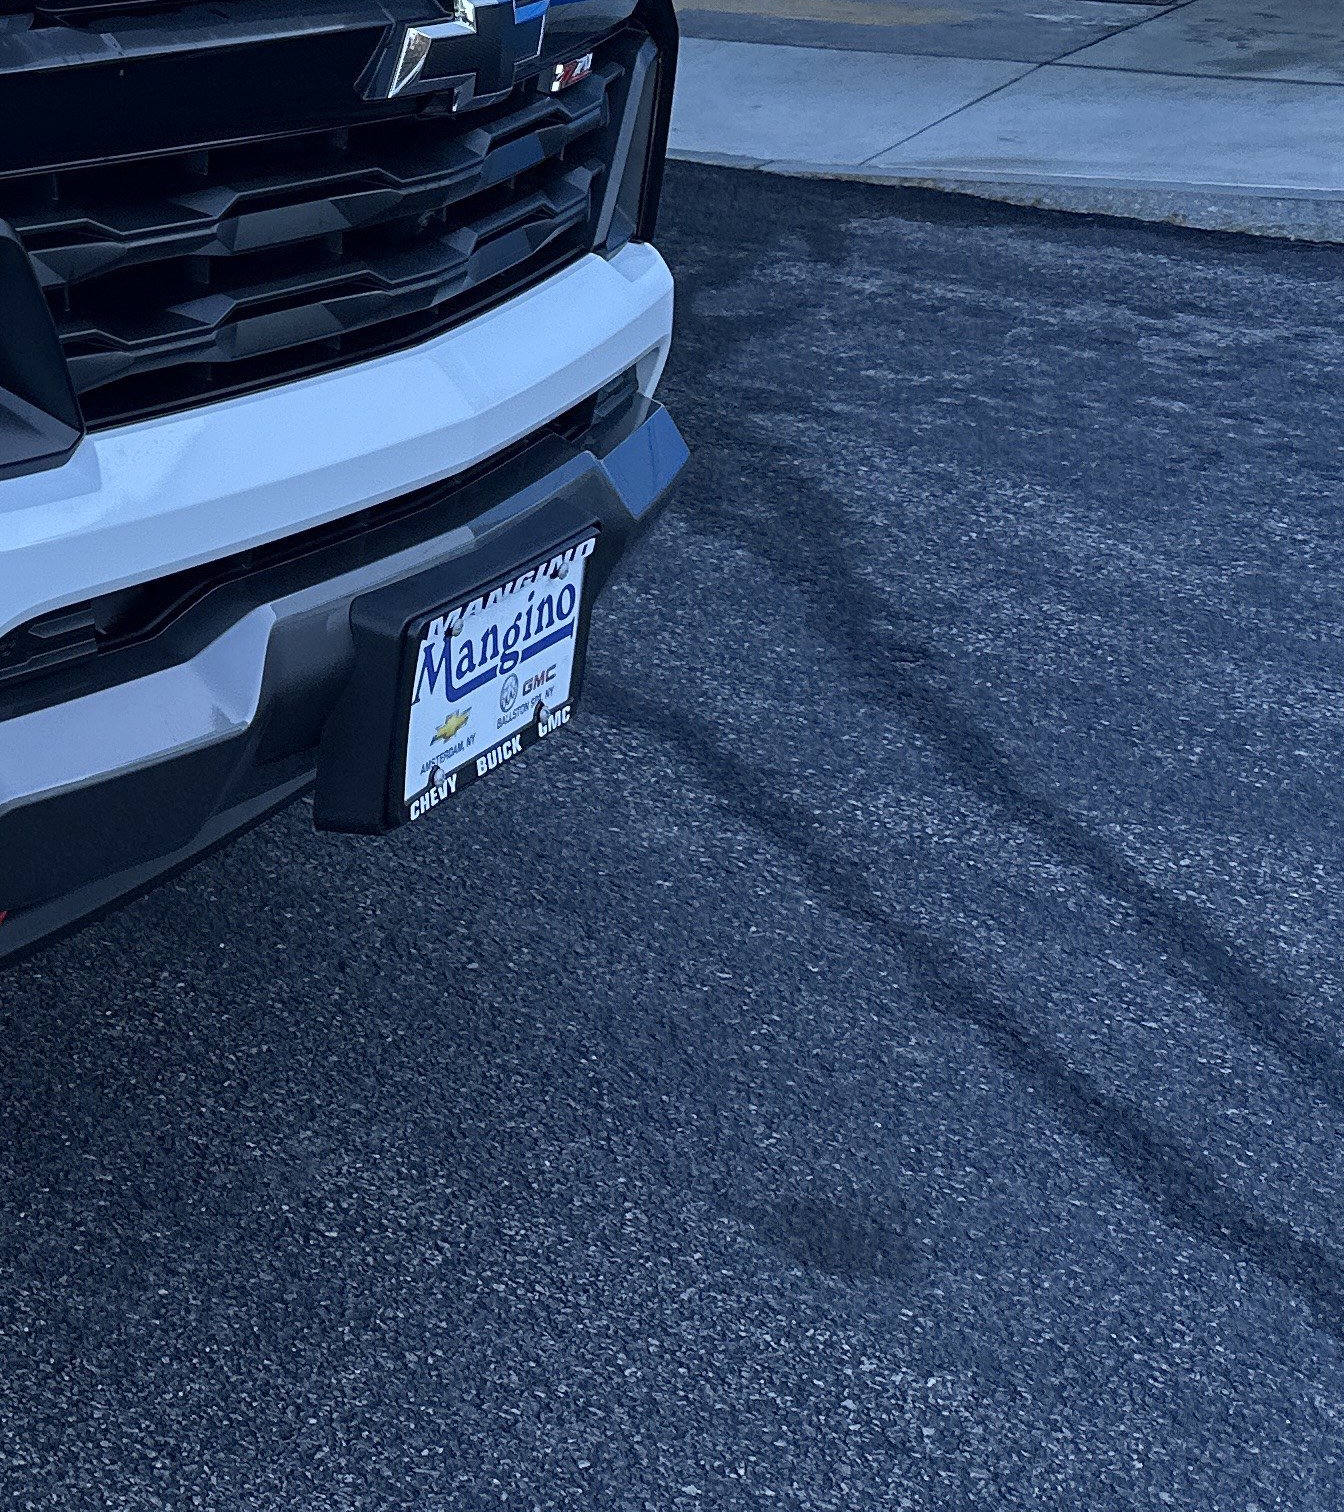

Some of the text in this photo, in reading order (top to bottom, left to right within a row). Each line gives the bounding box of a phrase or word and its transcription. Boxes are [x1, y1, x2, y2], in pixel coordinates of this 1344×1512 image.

[412, 584, 576, 702] Mangino
[522, 663, 557, 696] GMC
[410, 705, 572, 821] CHEVY BUICK GMC
